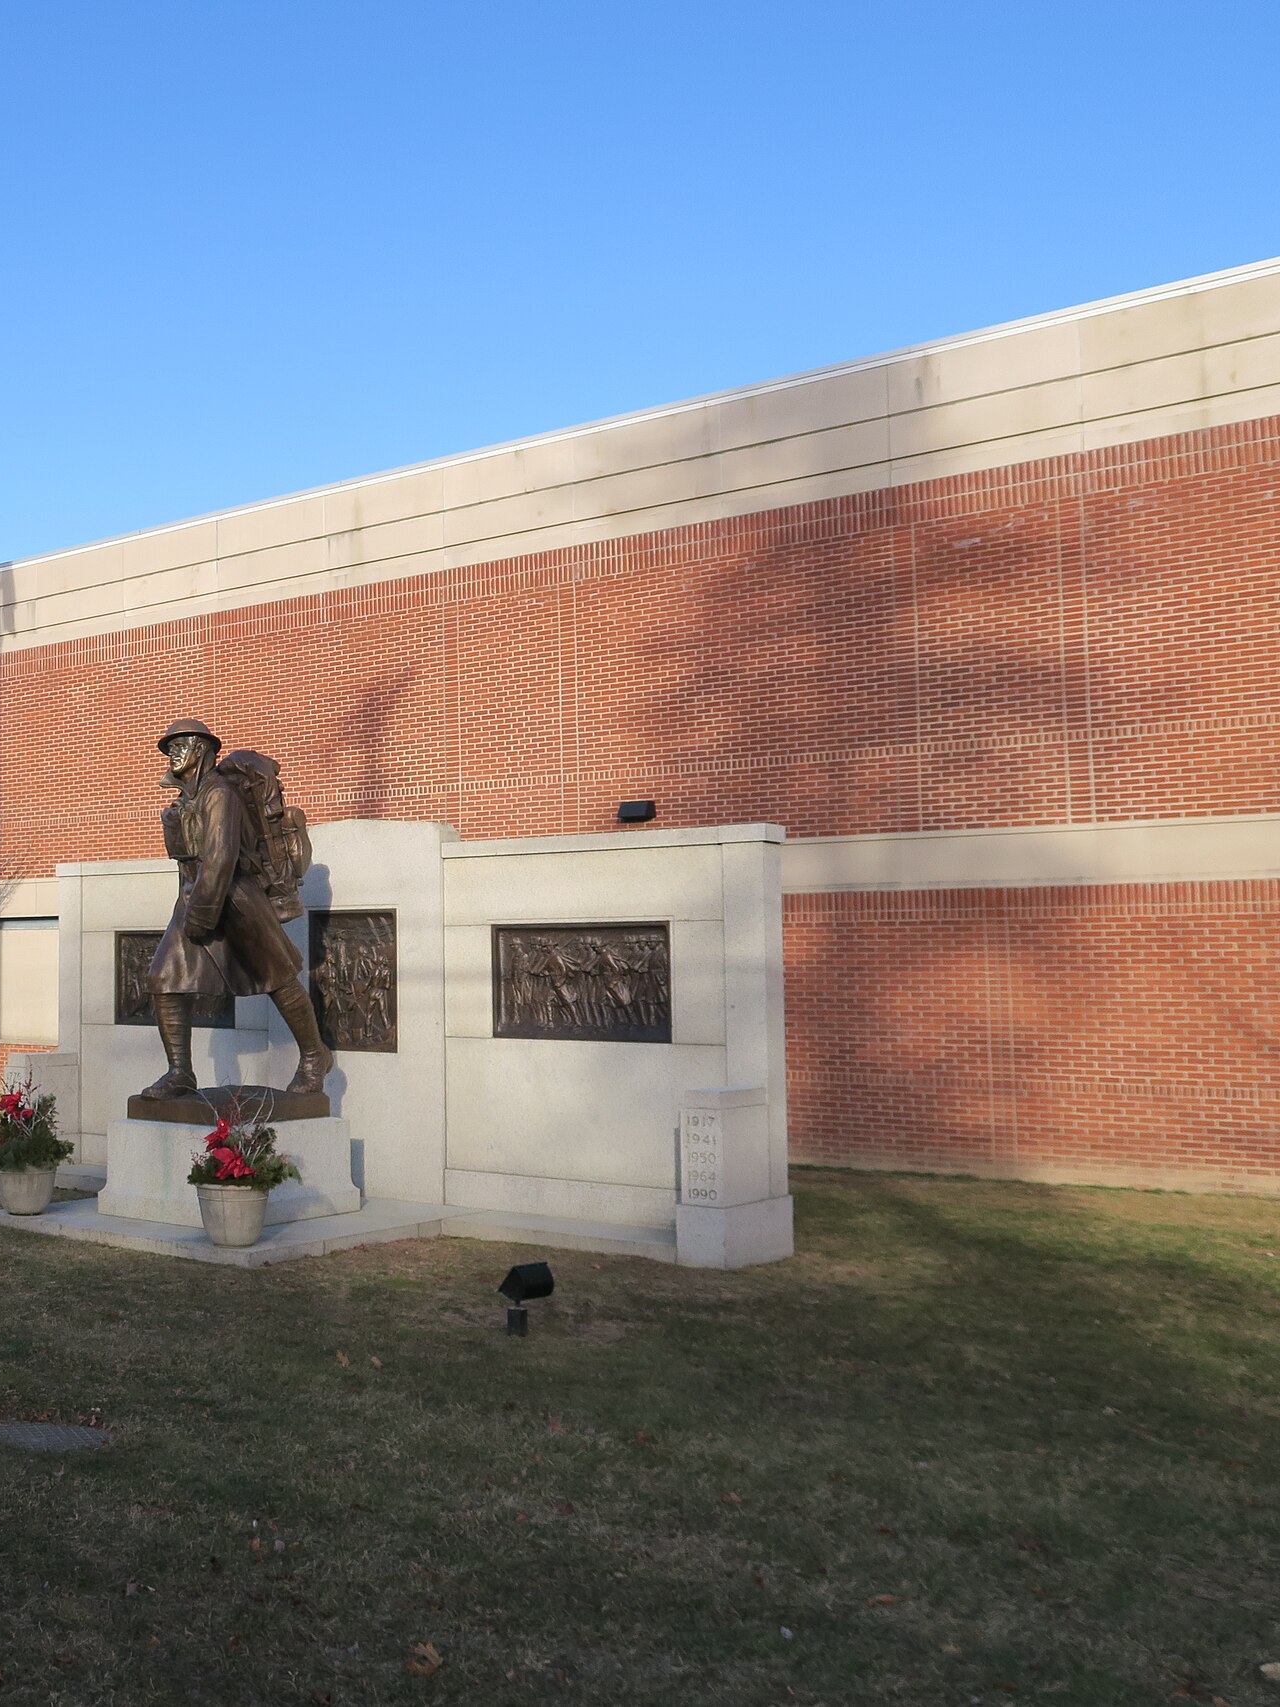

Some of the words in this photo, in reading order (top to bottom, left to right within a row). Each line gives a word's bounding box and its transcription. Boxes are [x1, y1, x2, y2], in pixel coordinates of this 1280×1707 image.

[686, 1114, 716, 1128] 1917
[686, 1132, 717, 1146] 1941
[687, 1151, 717, 1165] 1950
[687, 1169, 717, 1182] 1964
[687, 1187, 718, 1201] 1990
